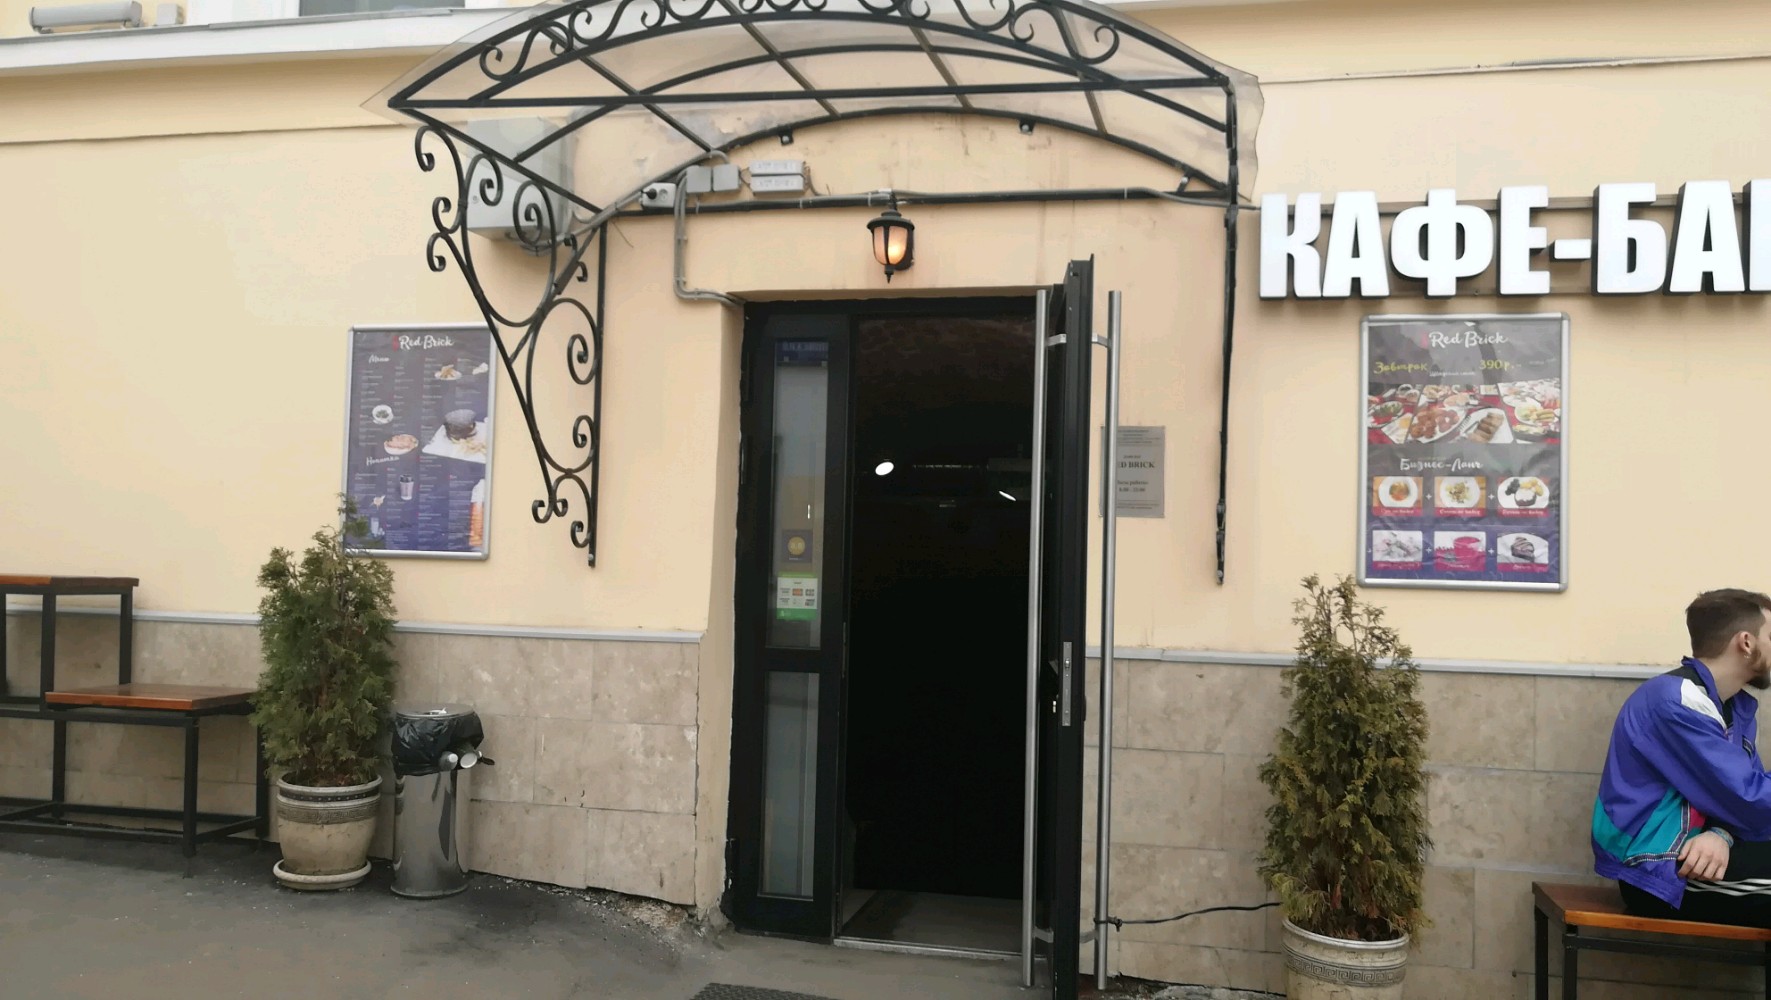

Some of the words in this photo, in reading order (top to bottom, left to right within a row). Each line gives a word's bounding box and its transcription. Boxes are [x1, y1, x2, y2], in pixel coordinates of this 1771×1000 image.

[398, 335, 421, 350] Red
[423, 335, 454, 349] Brick
[1428, 331, 1462, 349] Red
[1464, 331, 1508, 349] Brick
[1373, 361, 1428, 374] Завтрак
